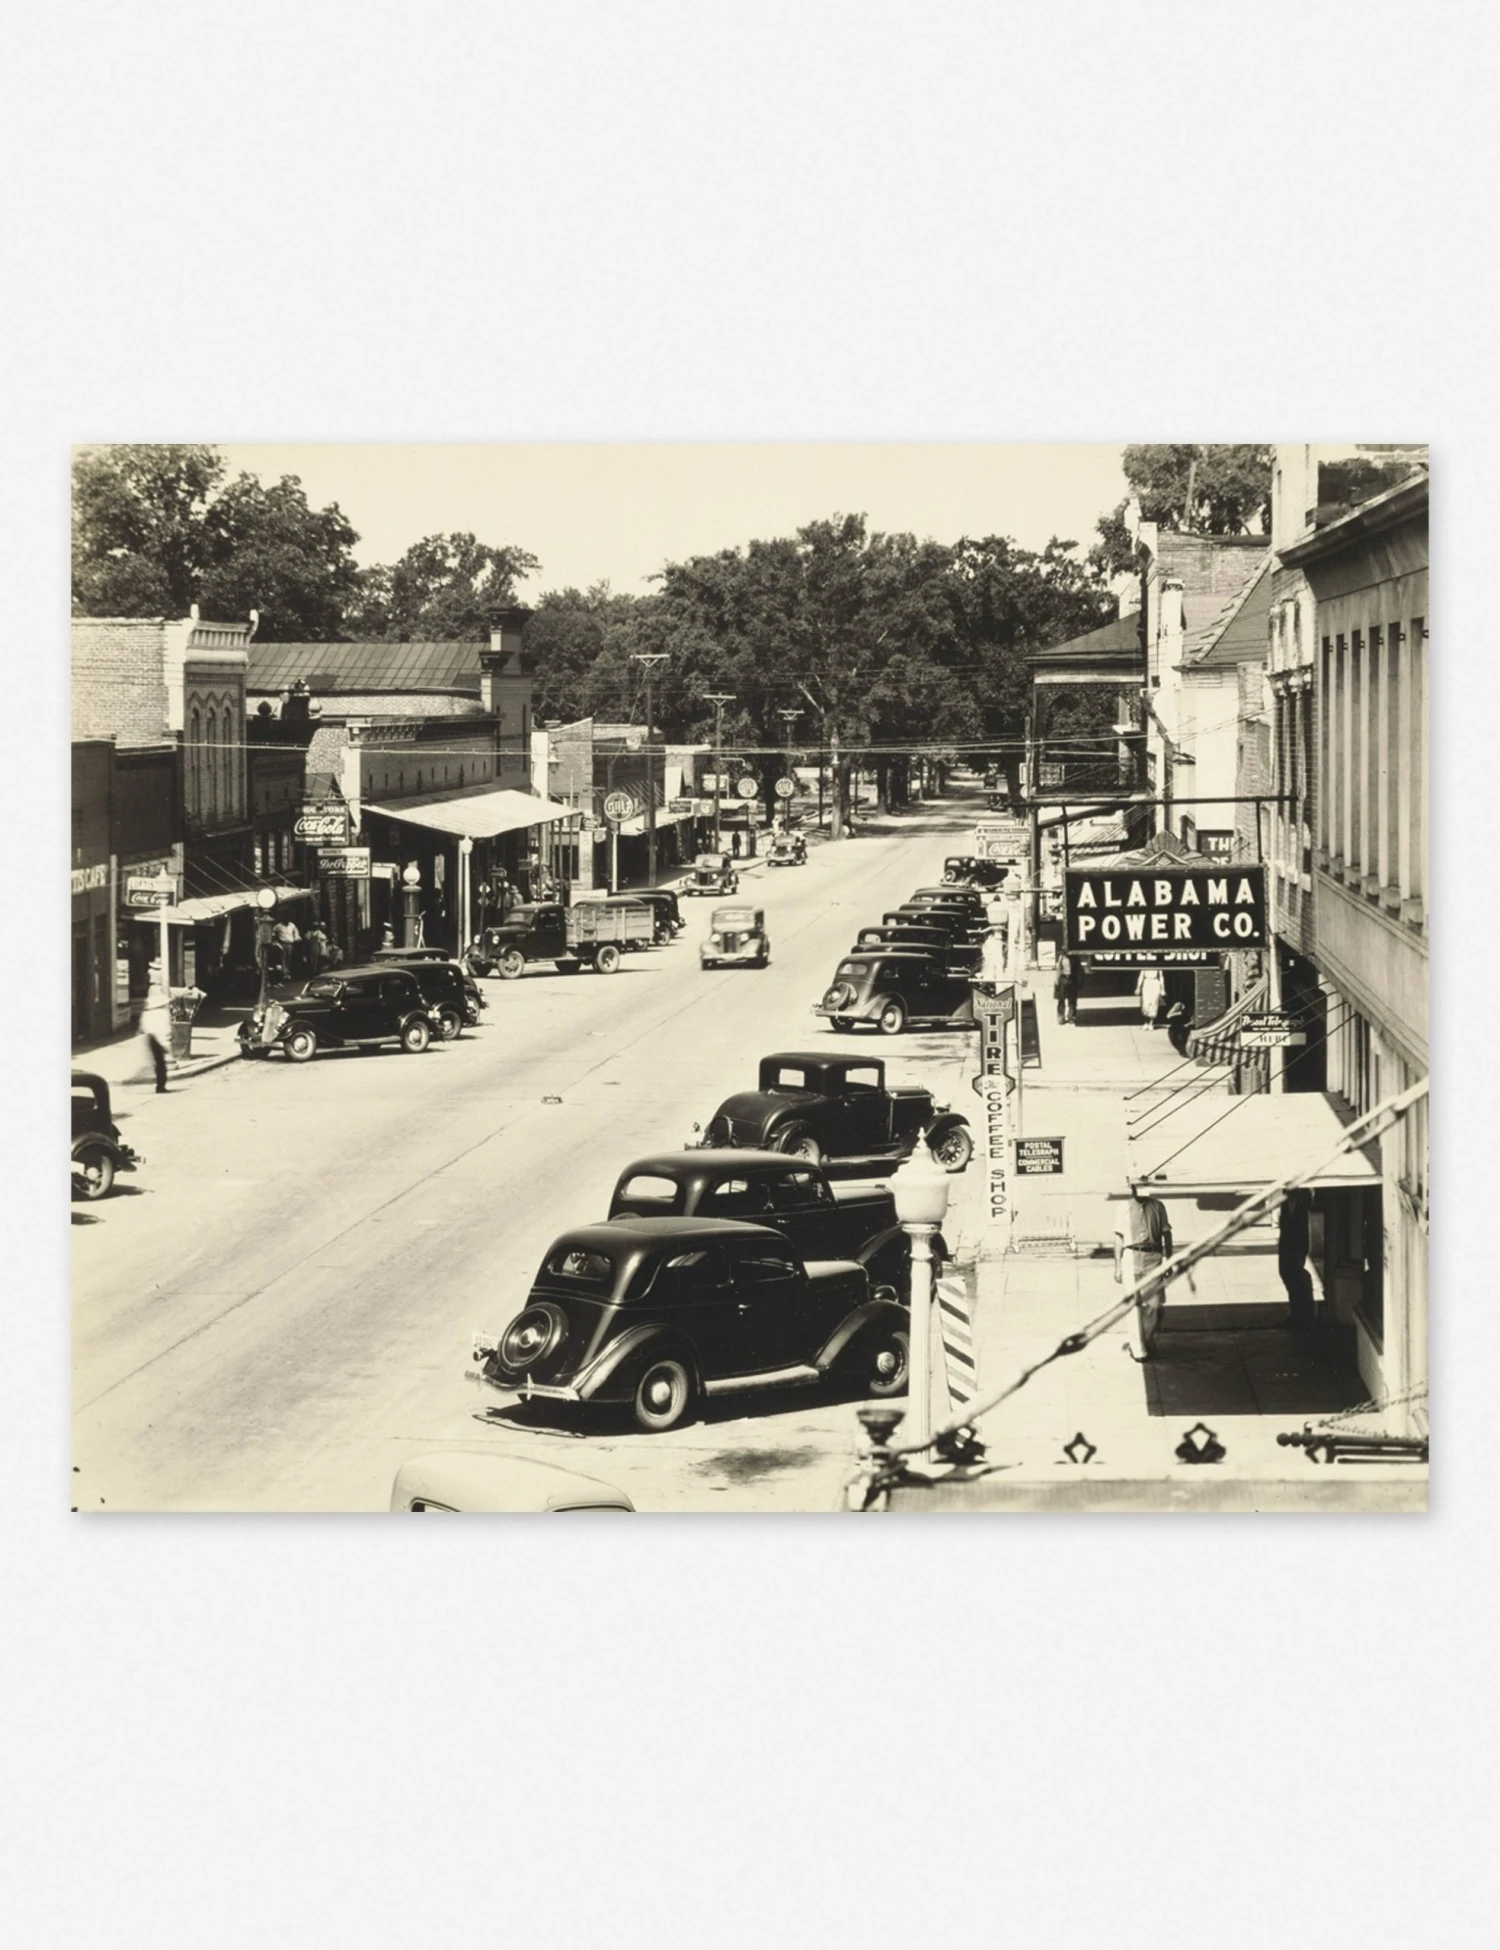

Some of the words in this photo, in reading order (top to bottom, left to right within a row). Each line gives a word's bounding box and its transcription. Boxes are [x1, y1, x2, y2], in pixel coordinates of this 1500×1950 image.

[607, 801, 632, 815] GULF
[1207, 837, 1234, 851] TH
[1077, 879, 1255, 908] ALABAMA
[1078, 912, 1192, 941] POWER
[1213, 912, 1260, 938] CO.
[984, 1013, 1002, 1076] TIRE
[986, 1091, 1004, 1159] COFFEE
[1018, 1158, 1060, 1166] COMMERCIAL
[1019, 1148, 1059, 1156] TELEGRAPH
[990, 1169, 1006, 1217] SHOP
